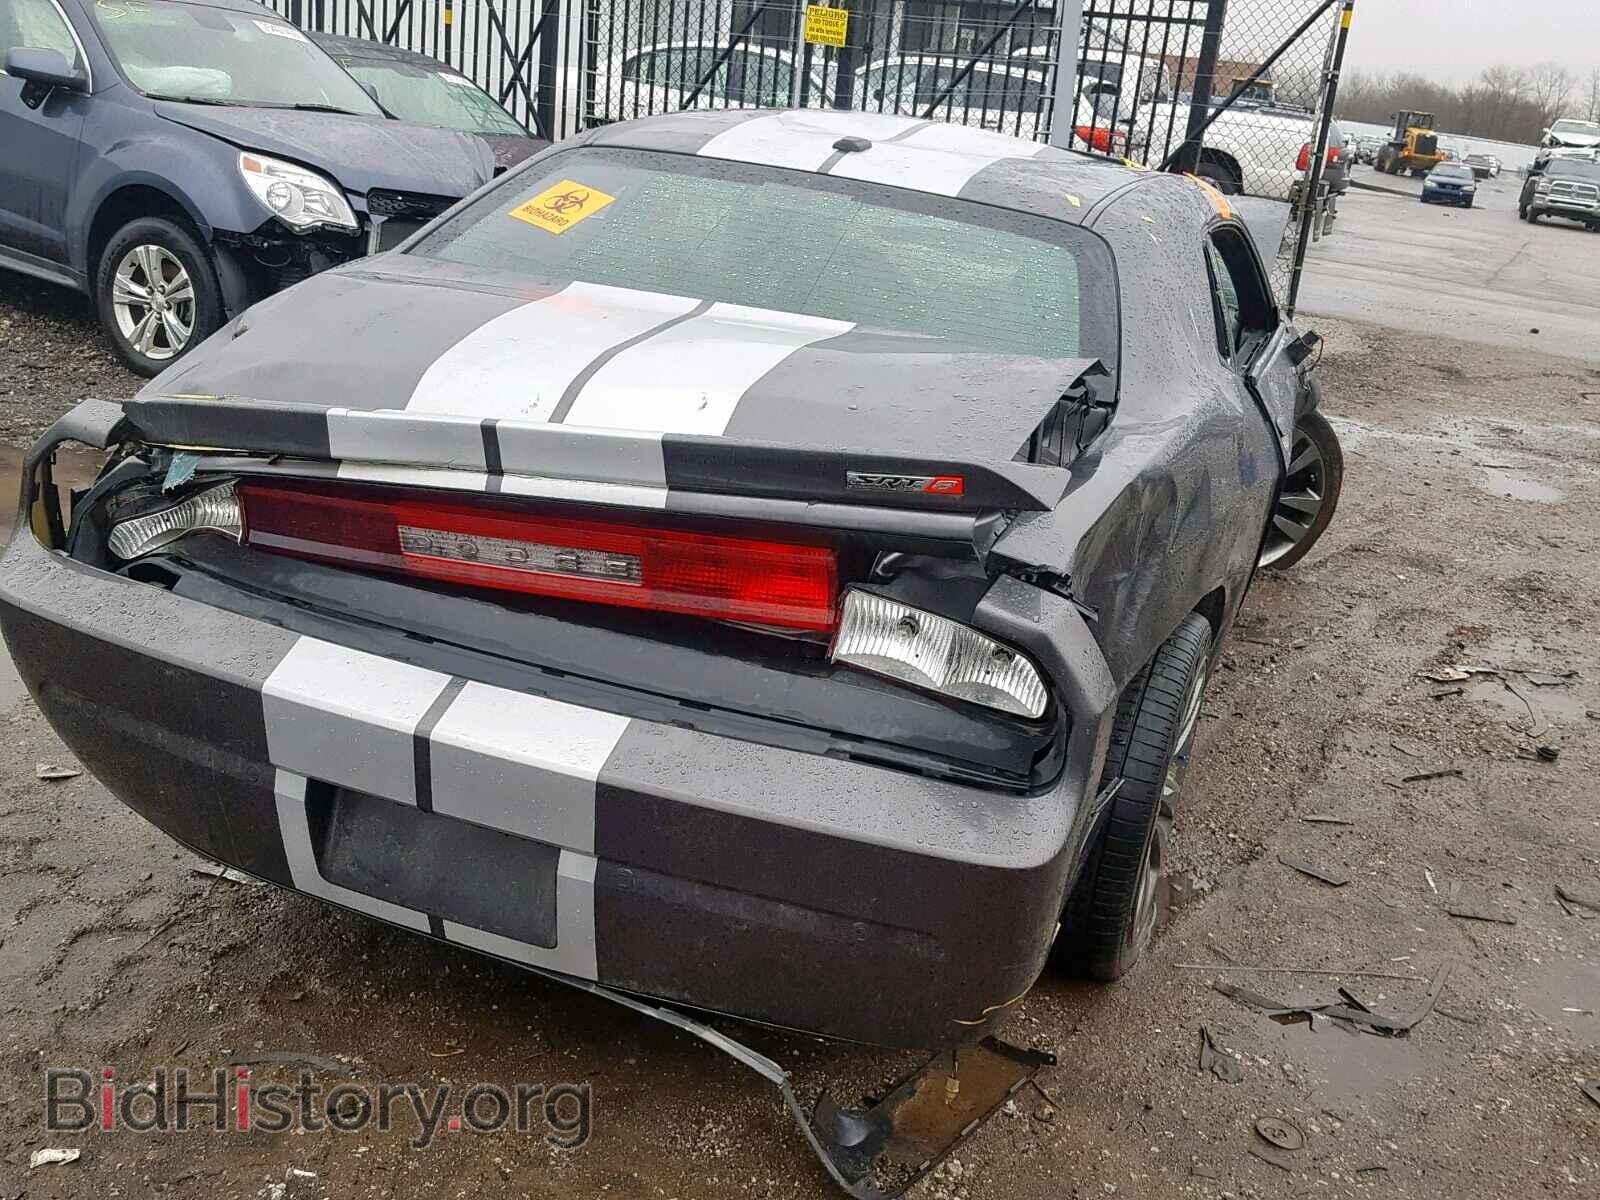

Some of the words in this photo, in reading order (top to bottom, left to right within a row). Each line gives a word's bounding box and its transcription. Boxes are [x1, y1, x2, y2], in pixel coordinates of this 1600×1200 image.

[809, 8, 846, 20] PELIGRO
[521, 205, 570, 227] BIOHAZARD
[407, 533, 633, 577] DODGE
